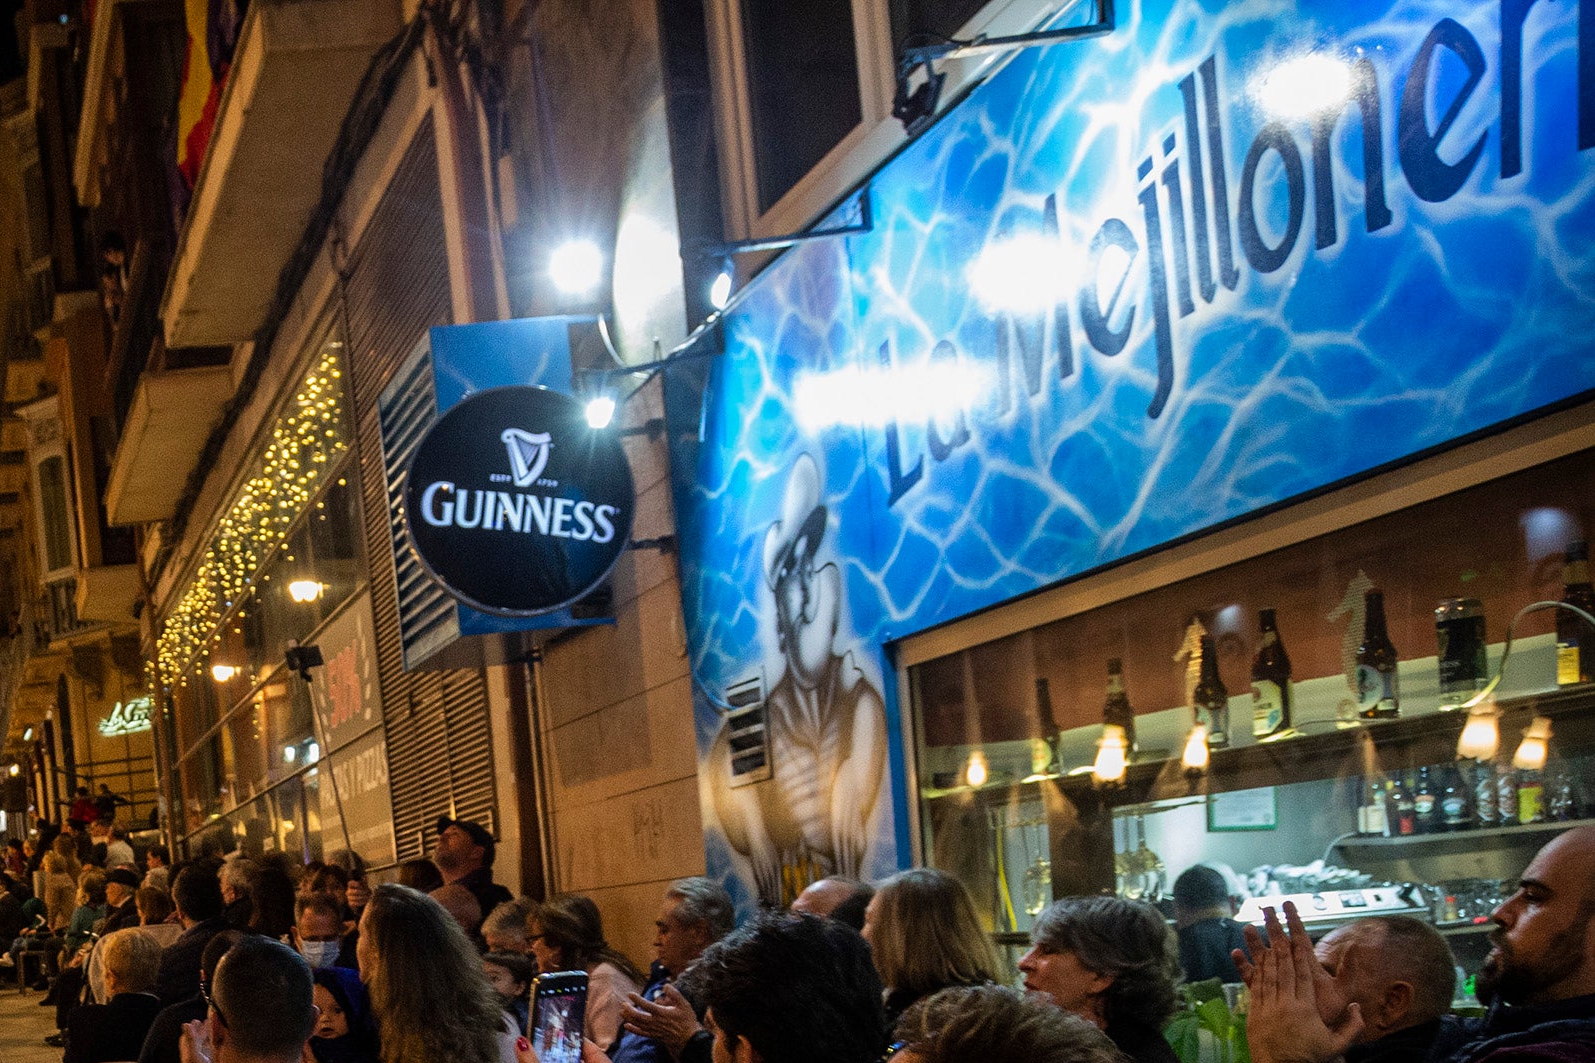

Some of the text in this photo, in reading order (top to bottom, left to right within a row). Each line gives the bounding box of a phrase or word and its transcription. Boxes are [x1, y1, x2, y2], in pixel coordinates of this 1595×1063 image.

[878, 0, 1595, 508] La Mejilloner
[420, 480, 616, 544] GUINNESS
